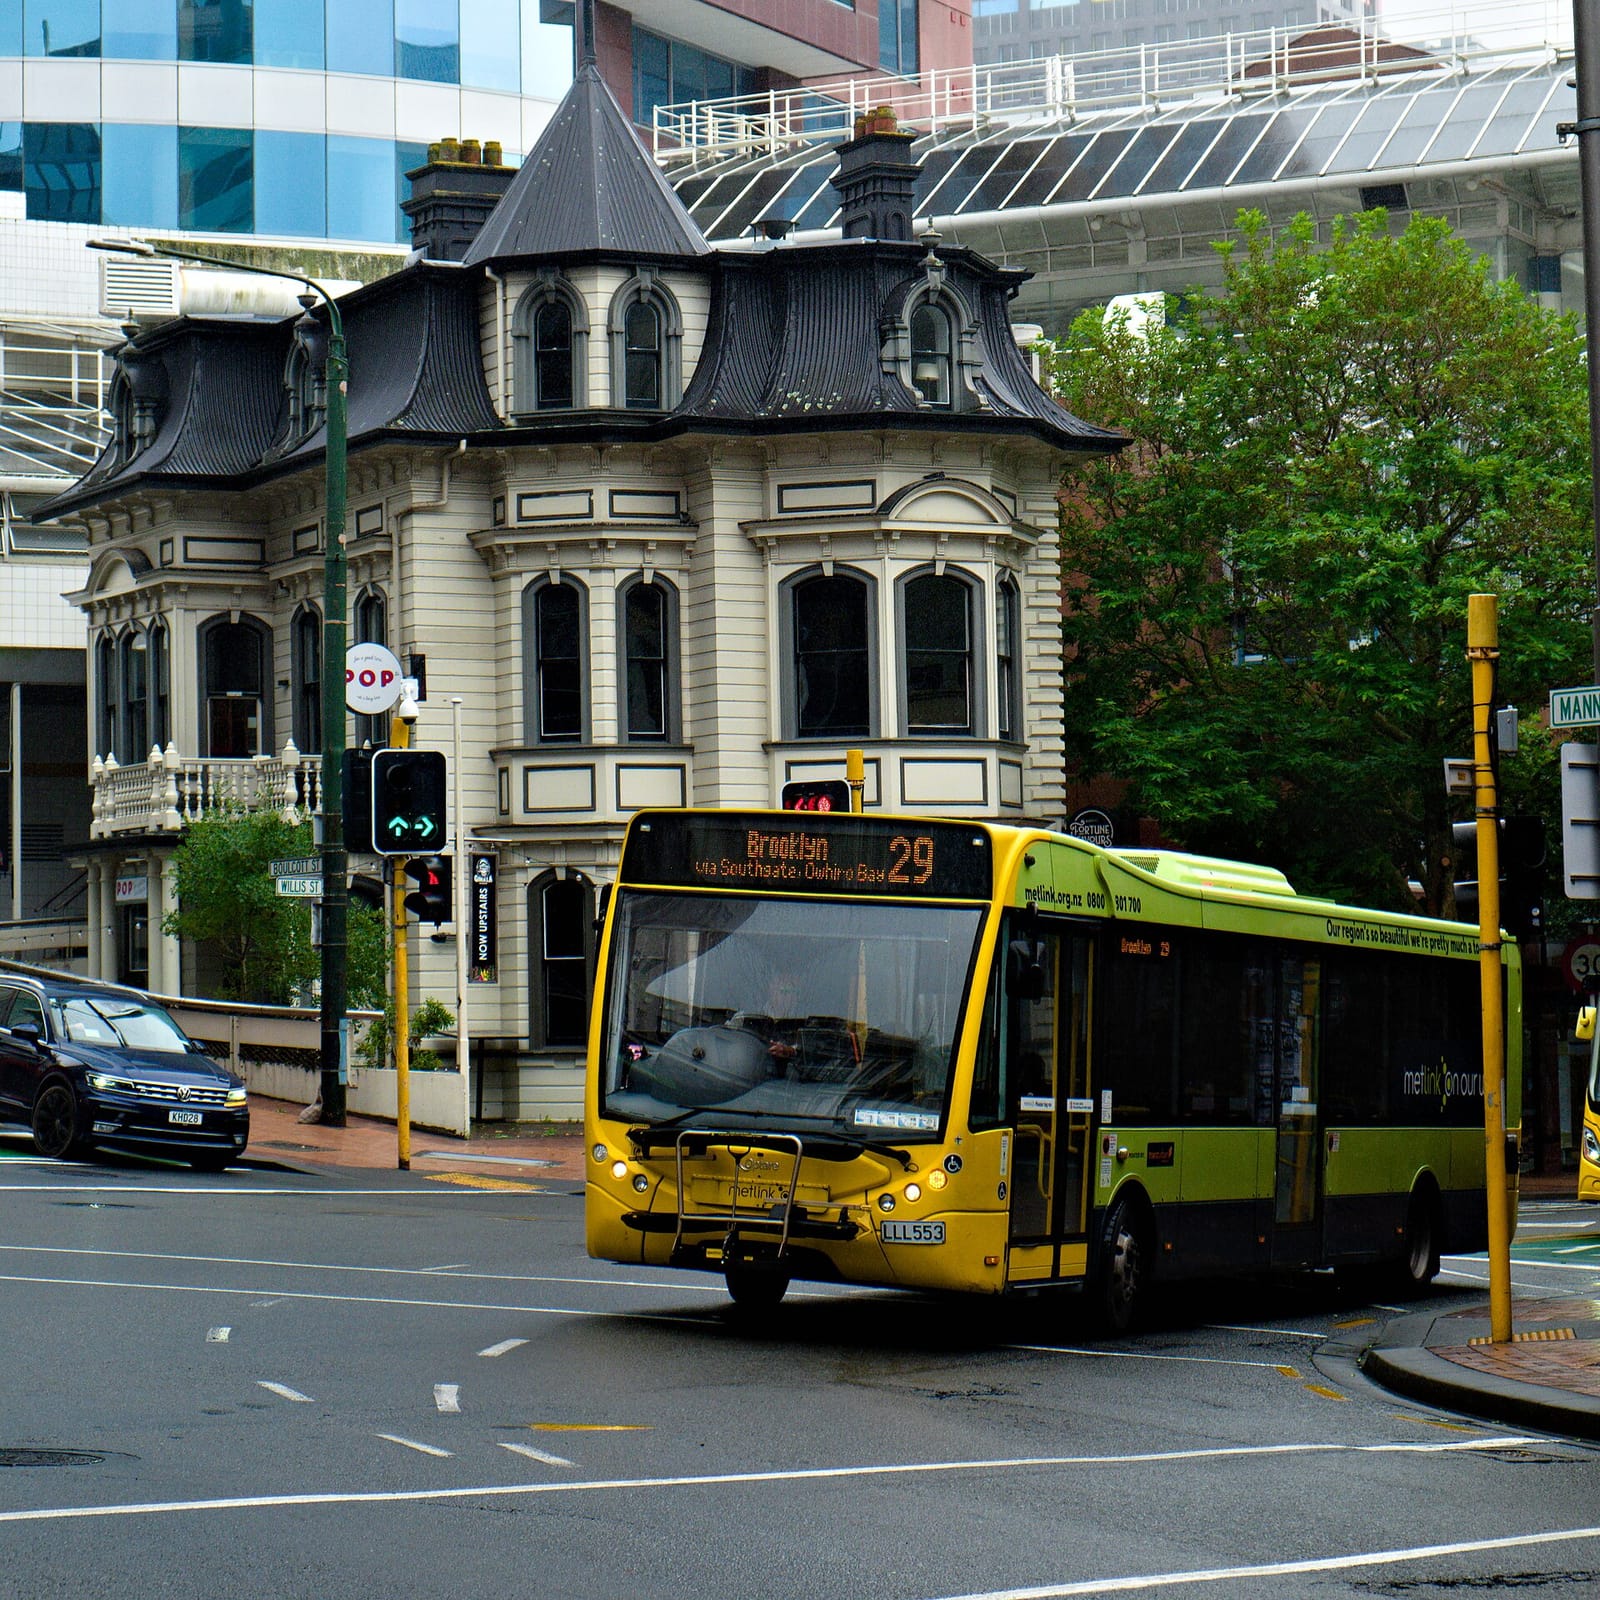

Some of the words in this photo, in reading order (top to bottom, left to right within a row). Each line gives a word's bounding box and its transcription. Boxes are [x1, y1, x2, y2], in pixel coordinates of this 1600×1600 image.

[1070, 819, 1110, 836] FORTUNE
[273, 860, 308, 875] BOULCOTT
[311, 858, 320, 872] ST
[746, 830, 828, 861] Brooklyn
[887, 836, 934, 884] 29
[695, 857, 717, 876] via
[857, 863, 885, 883] Bay
[116, 880, 133, 896] POP
[281, 880, 306, 893] WILLIS
[310, 880, 319, 893] ST
[479, 887, 488, 932] UPSTAIRS
[1025, 885, 1082, 909] metlink.org.nz
[1086, 892, 1105, 910] 0800
[1128, 896, 1142, 913] 700
[479, 934, 488, 961] NOW
[1327, 919, 1340, 937] Our
[1342, 920, 1370, 944] region's
[1370, 928, 1379, 943] so
[1379, 924, 1410, 946] beautiful
[1411, 930, 1429, 949] we're
[1429, 935, 1450, 956] pretty
[1450, 936, 1468, 954] much
[1468, 941, 1473, 954] a
[1404, 1063, 1441, 1095] metlink
[1461, 1072, 1478, 1097] our
[172, 1112, 199, 1124] KHD28
[728, 1184, 776, 1199] metlink
[883, 1223, 944, 1241] LLL553
